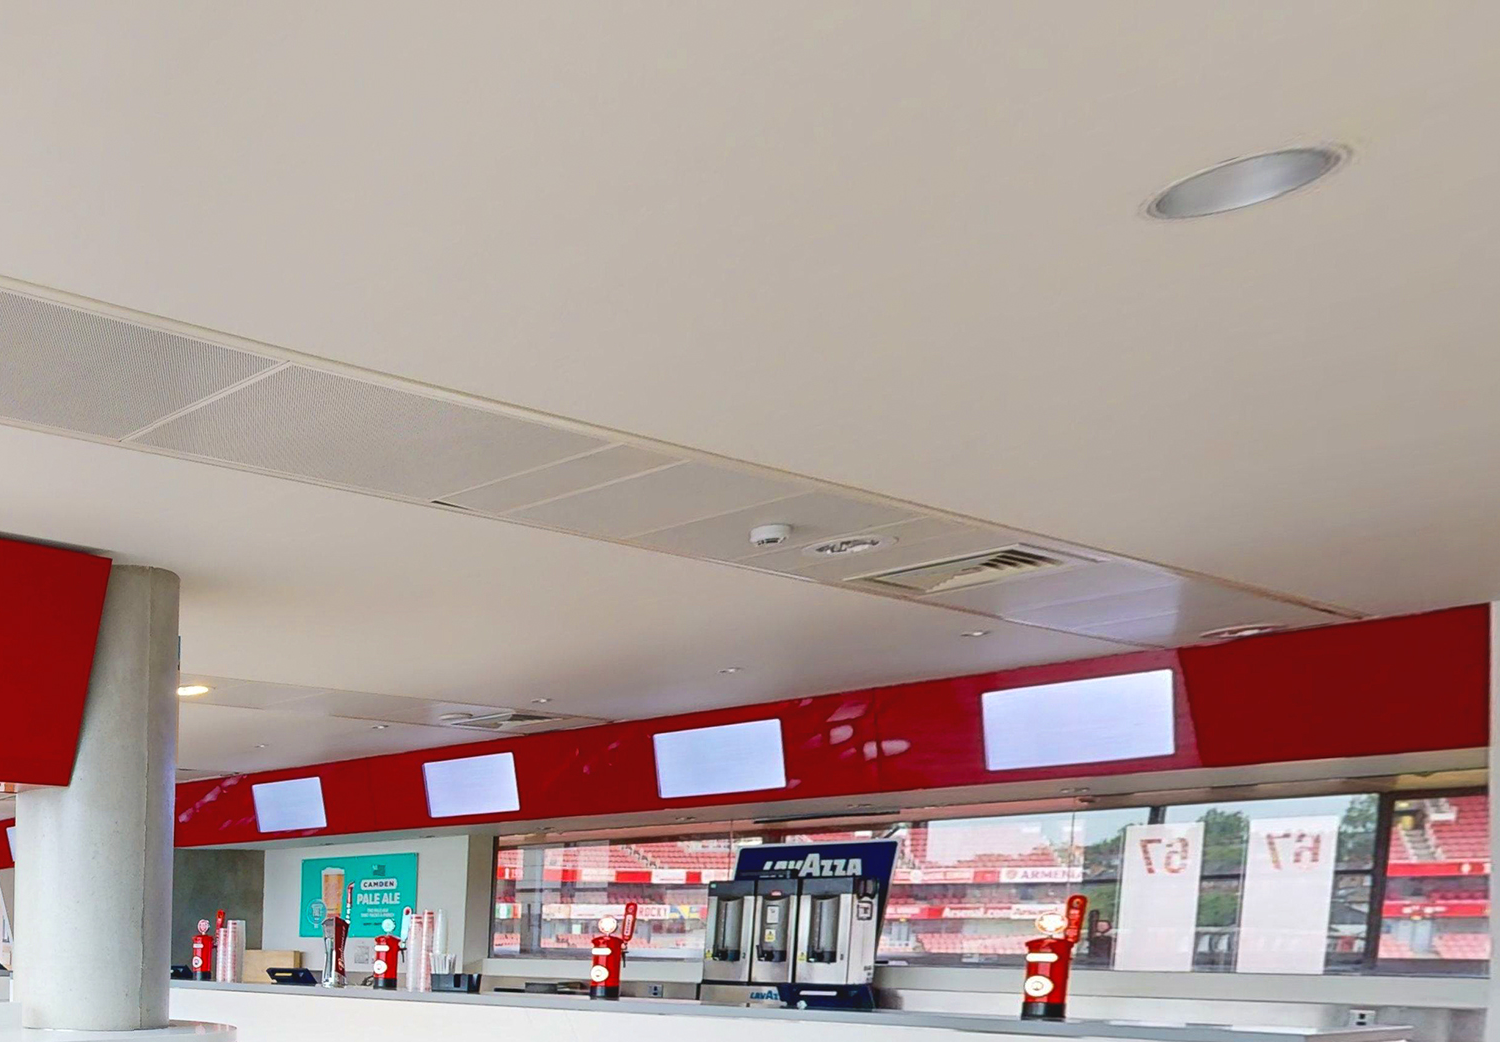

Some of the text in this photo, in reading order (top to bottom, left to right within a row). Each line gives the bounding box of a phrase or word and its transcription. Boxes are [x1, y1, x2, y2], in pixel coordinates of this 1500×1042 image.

[762, 853, 863, 877] LAVAZZA
[362, 880, 395, 888] CAMDEN
[357, 892, 400, 905] PALE ALE
